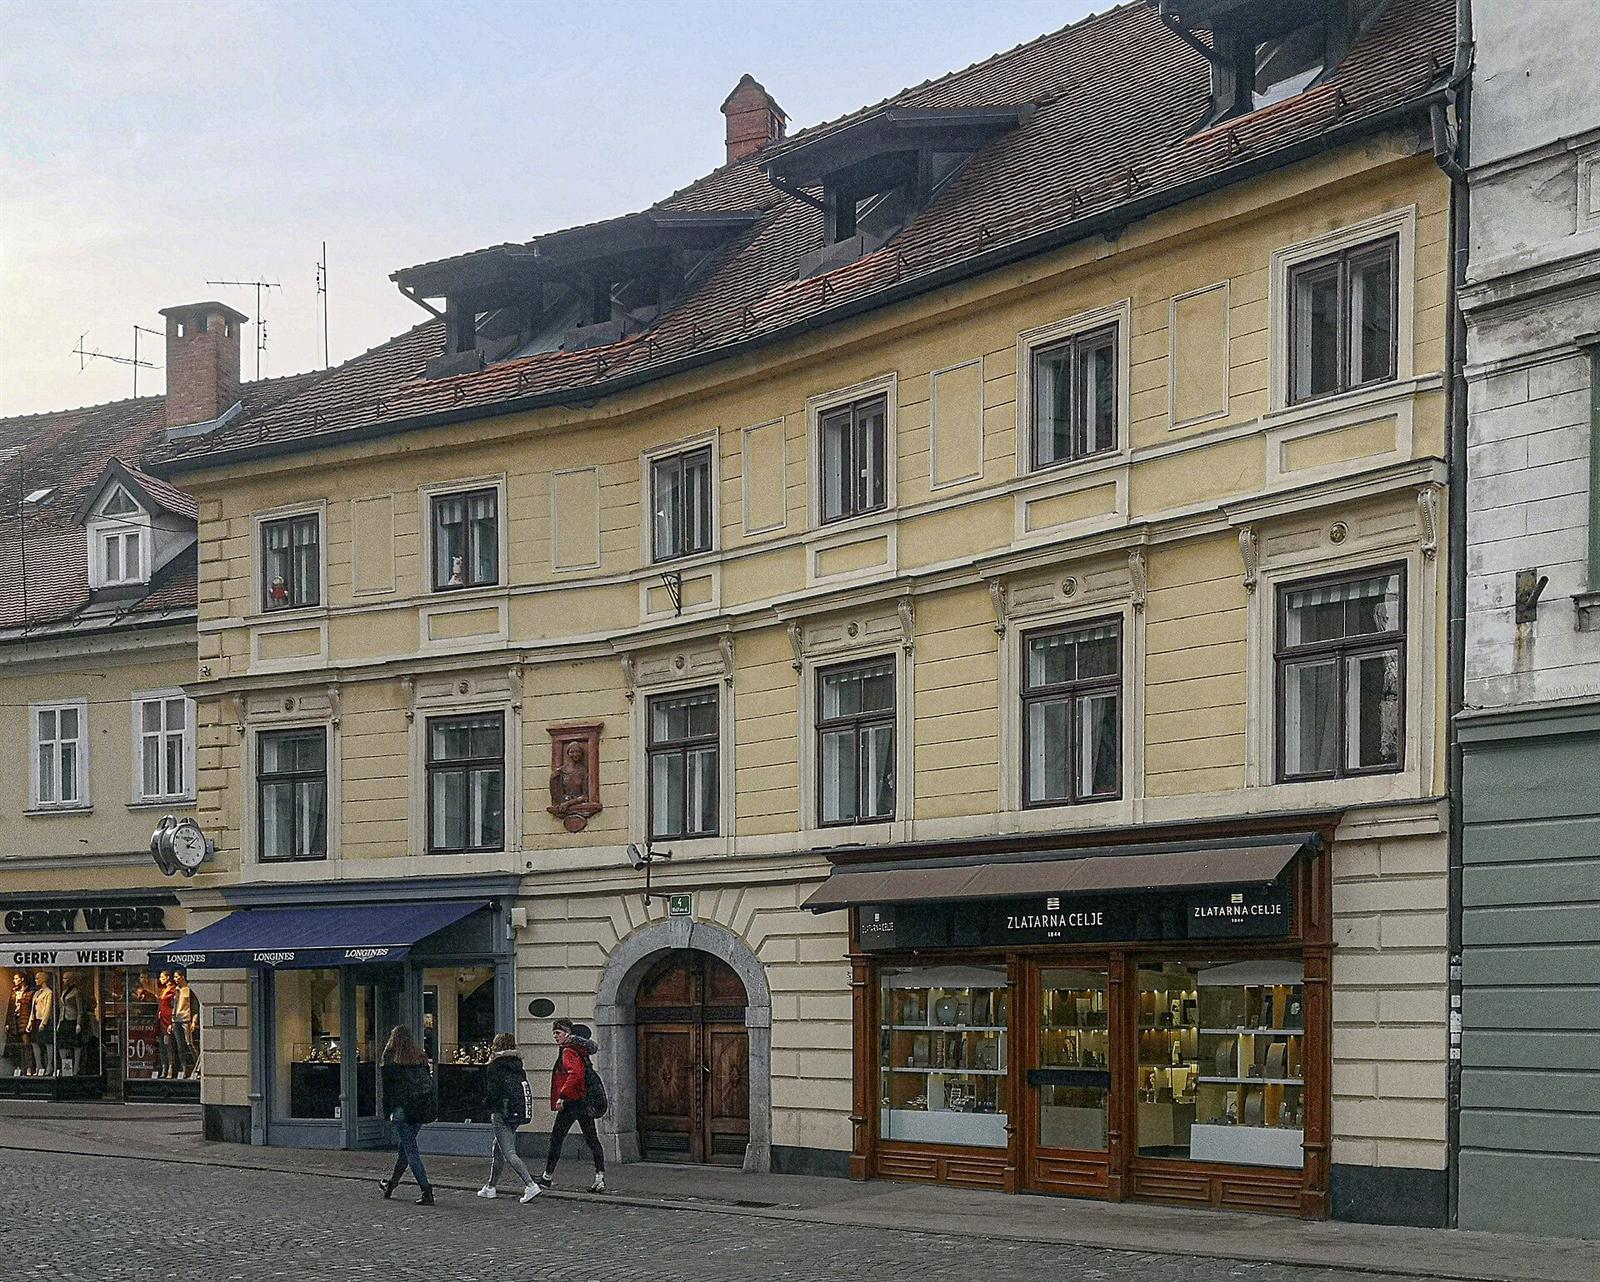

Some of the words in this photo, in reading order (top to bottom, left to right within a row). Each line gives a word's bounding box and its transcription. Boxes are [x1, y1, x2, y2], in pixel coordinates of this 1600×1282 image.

[1194, 905, 1249, 917] ZLATARNA
[1250, 904, 1282, 915] CELJE
[5, 908, 79, 933] GERRY
[82, 906, 166, 931] WEBER
[1007, 914, 1067, 929] ZLATARNA
[1068, 912, 1103, 927] CELJE
[13, 951, 58, 964] GERRY
[77, 950, 124, 963] WEBER
[166, 954, 206, 963] LONGINES
[253, 952, 295, 962] LONGINES
[345, 948, 389, 958] LONGINES
